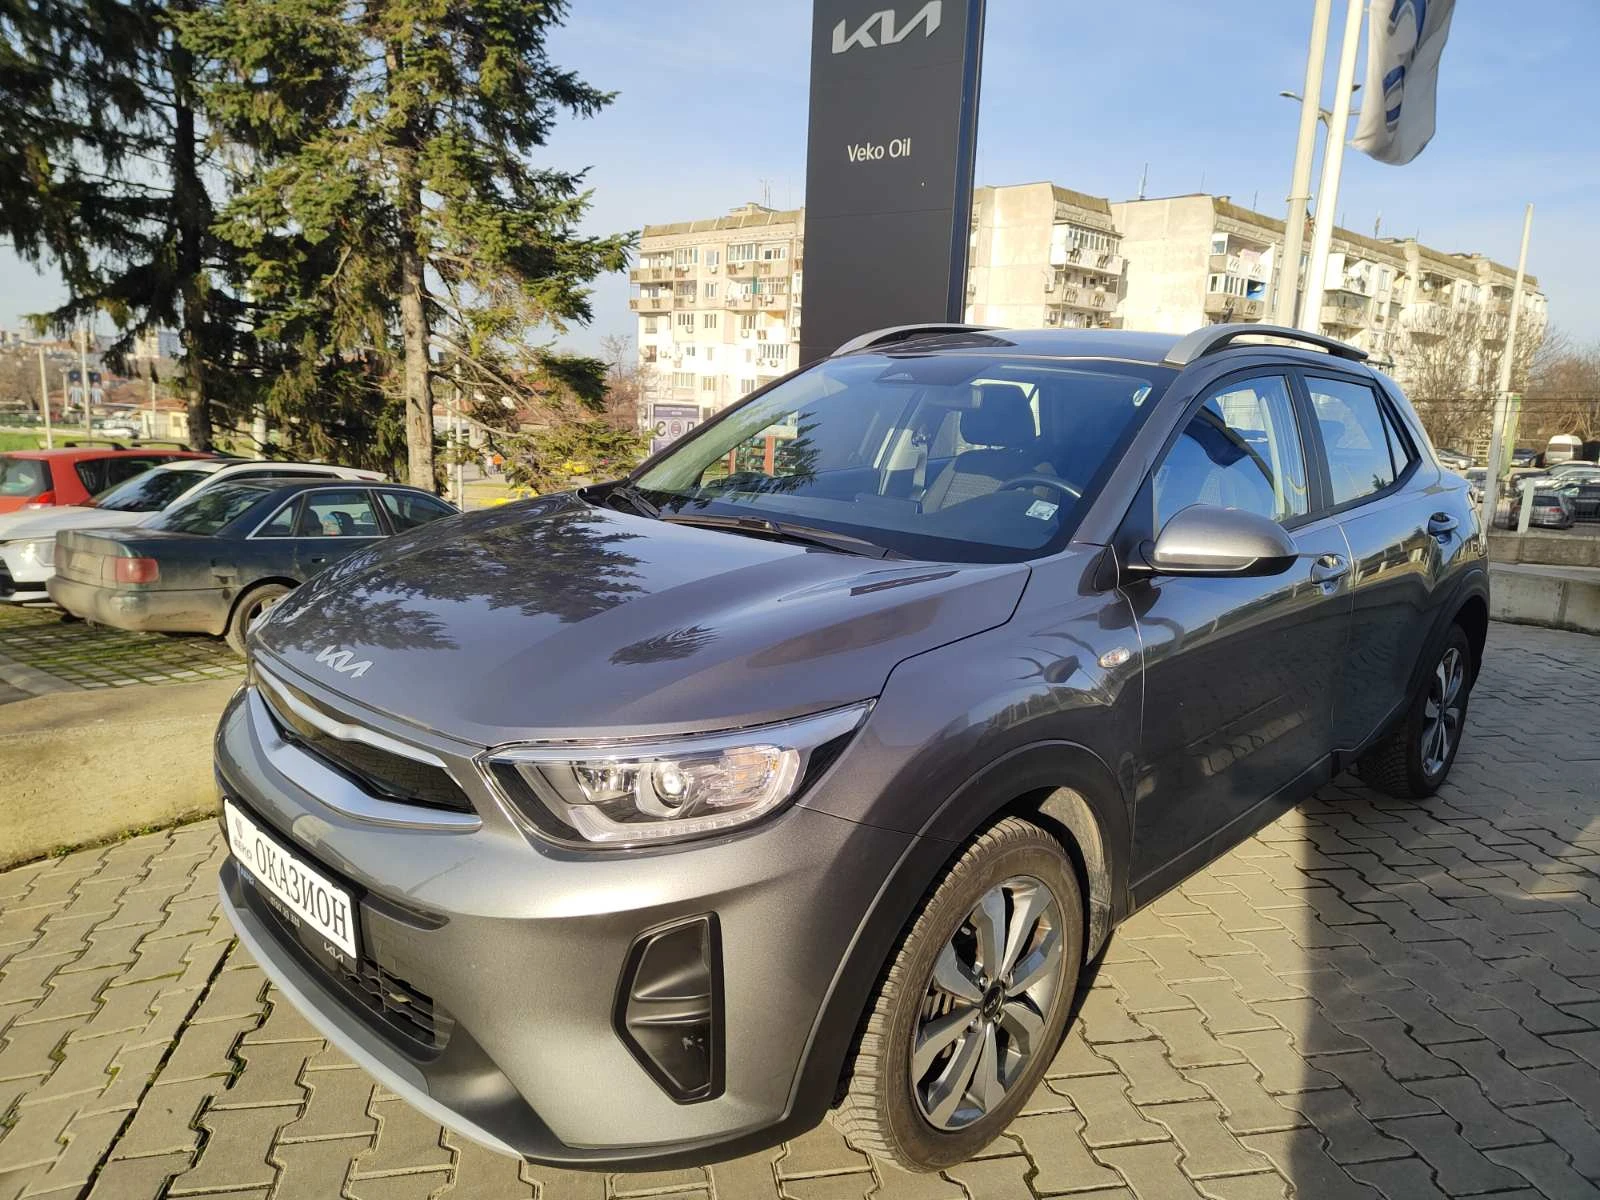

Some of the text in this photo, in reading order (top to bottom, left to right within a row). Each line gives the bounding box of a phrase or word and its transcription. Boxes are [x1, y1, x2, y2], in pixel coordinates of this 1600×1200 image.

[847, 137, 912, 162] Veko Oil
[255, 837, 349, 943] ОКАЗИОН
